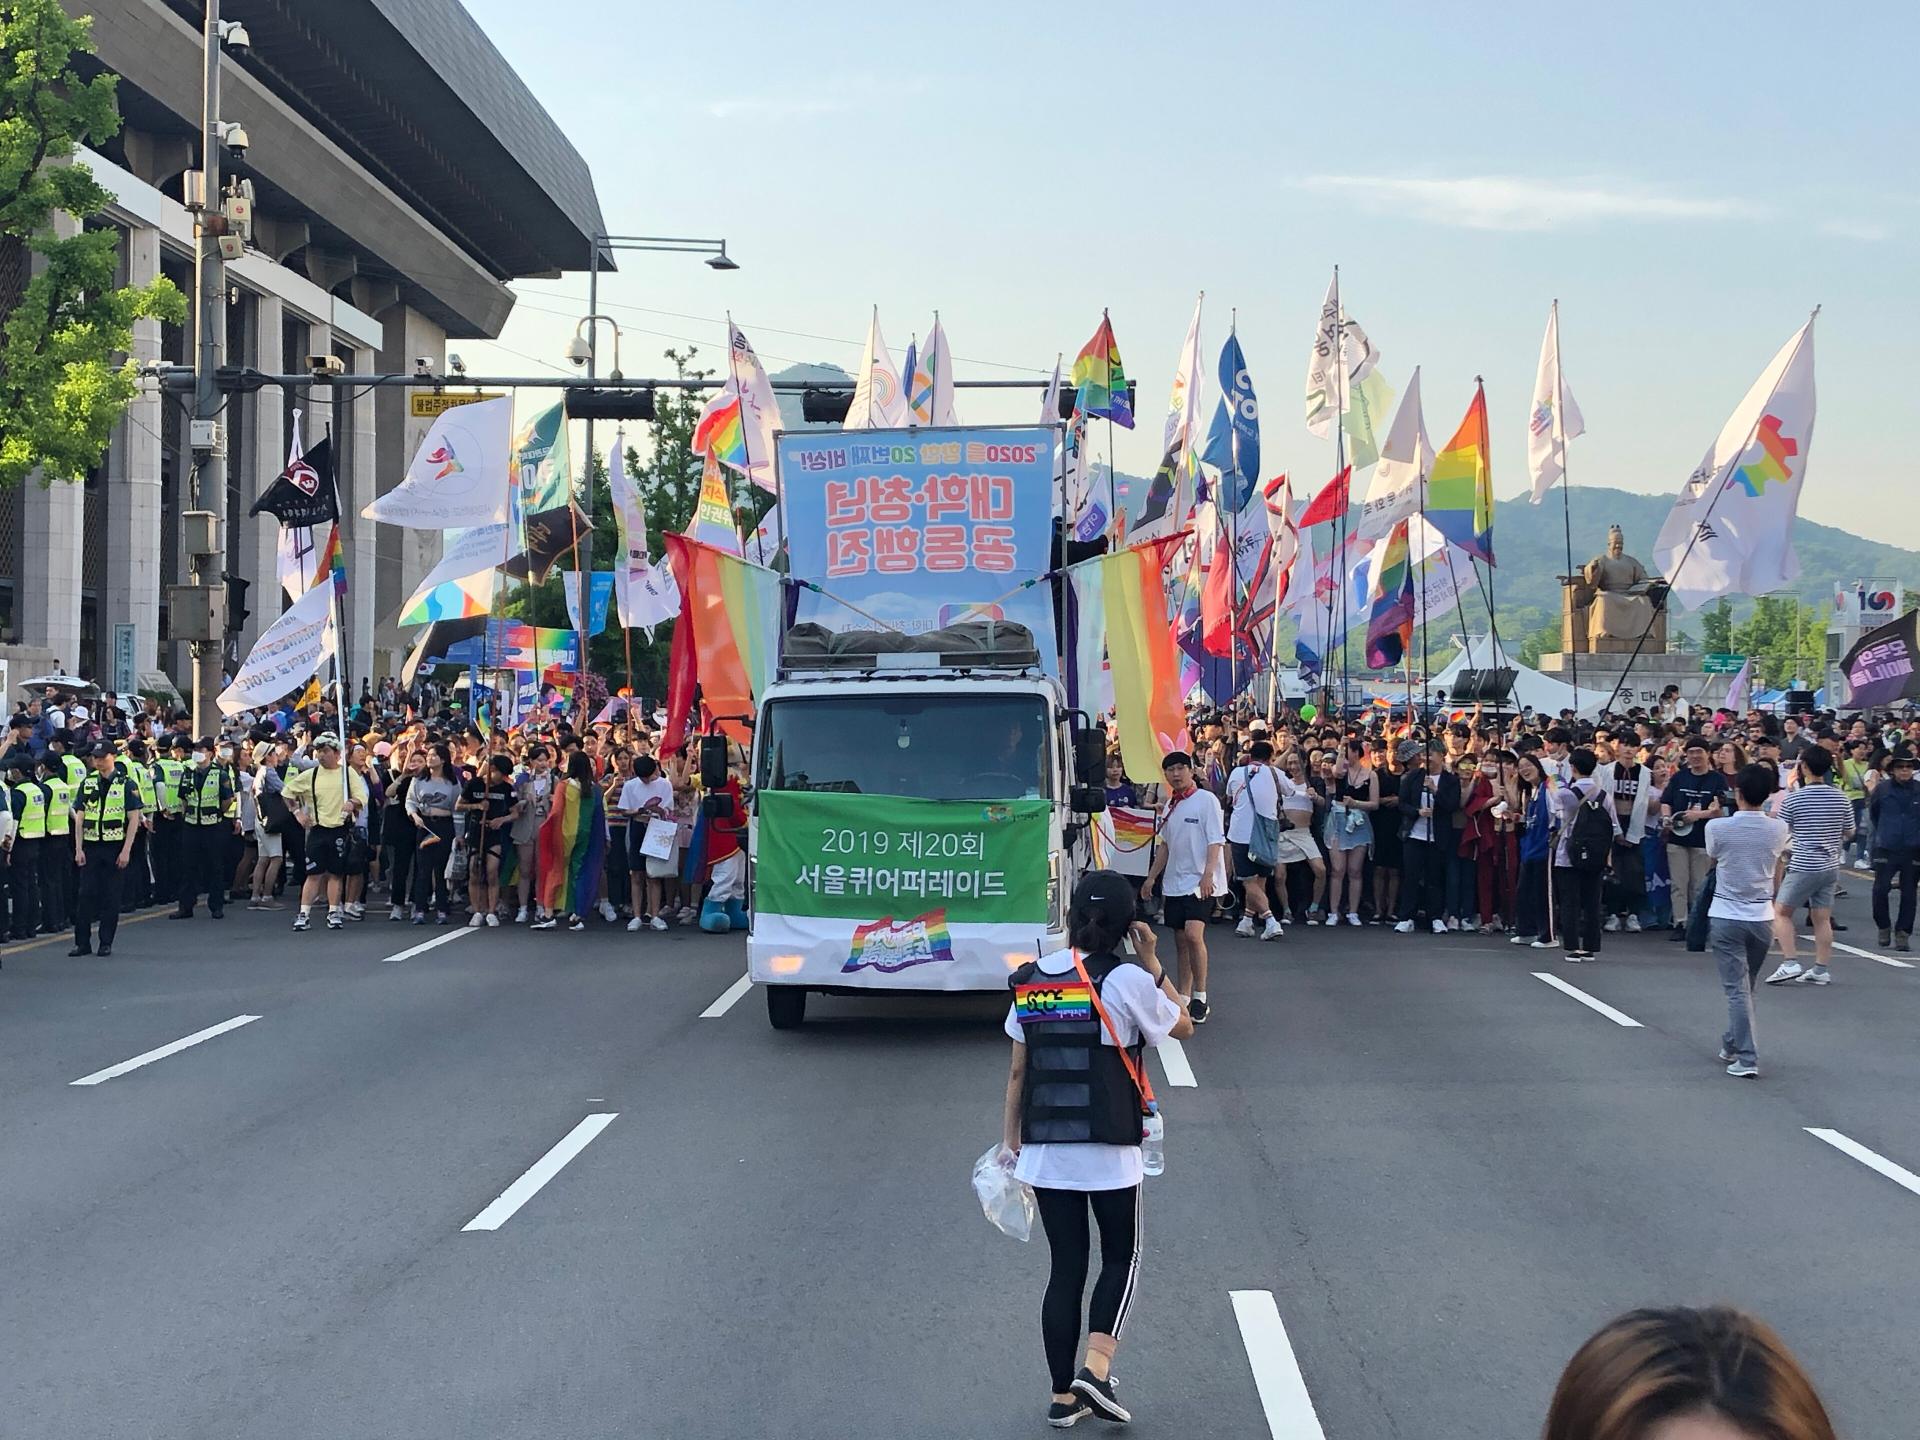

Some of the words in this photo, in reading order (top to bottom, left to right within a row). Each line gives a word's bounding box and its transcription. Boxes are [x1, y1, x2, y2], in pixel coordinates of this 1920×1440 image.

[1618, 687, 1658, 705] 종대
[821, 829, 889, 855] 2019
[896, 831, 985, 861] 제20회
[794, 864, 1008, 900] 서울퀴어퍼레이드
